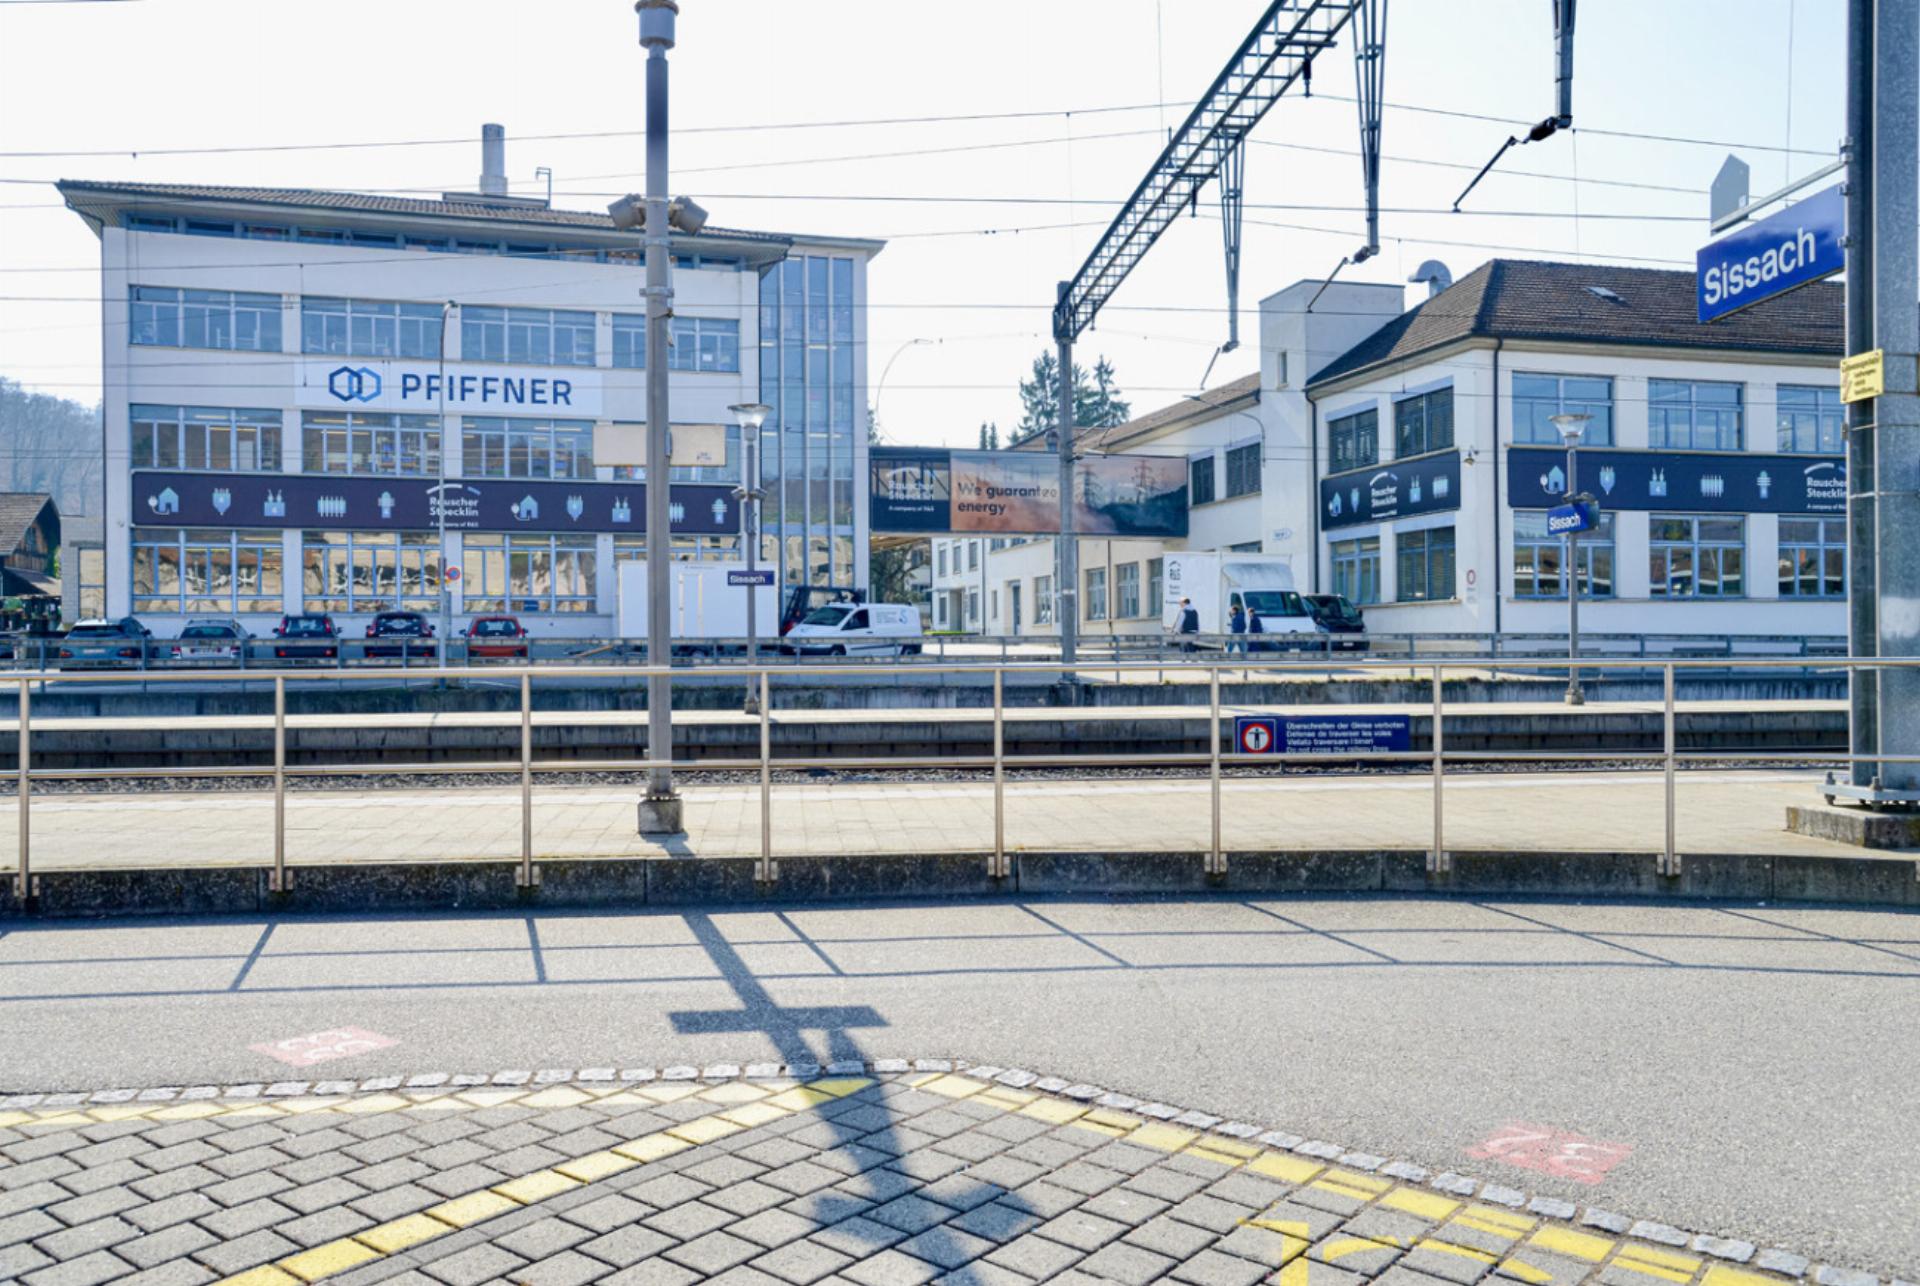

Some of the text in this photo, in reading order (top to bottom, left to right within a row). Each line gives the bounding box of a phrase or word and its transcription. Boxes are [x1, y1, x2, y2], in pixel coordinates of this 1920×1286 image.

[1704, 228, 1816, 304] Sissach
[402, 374, 572, 405] PFIFFNER
[958, 482, 1057, 498] We guarantee
[958, 502, 1006, 515] energy
[1549, 513, 1580, 530] Sissach
